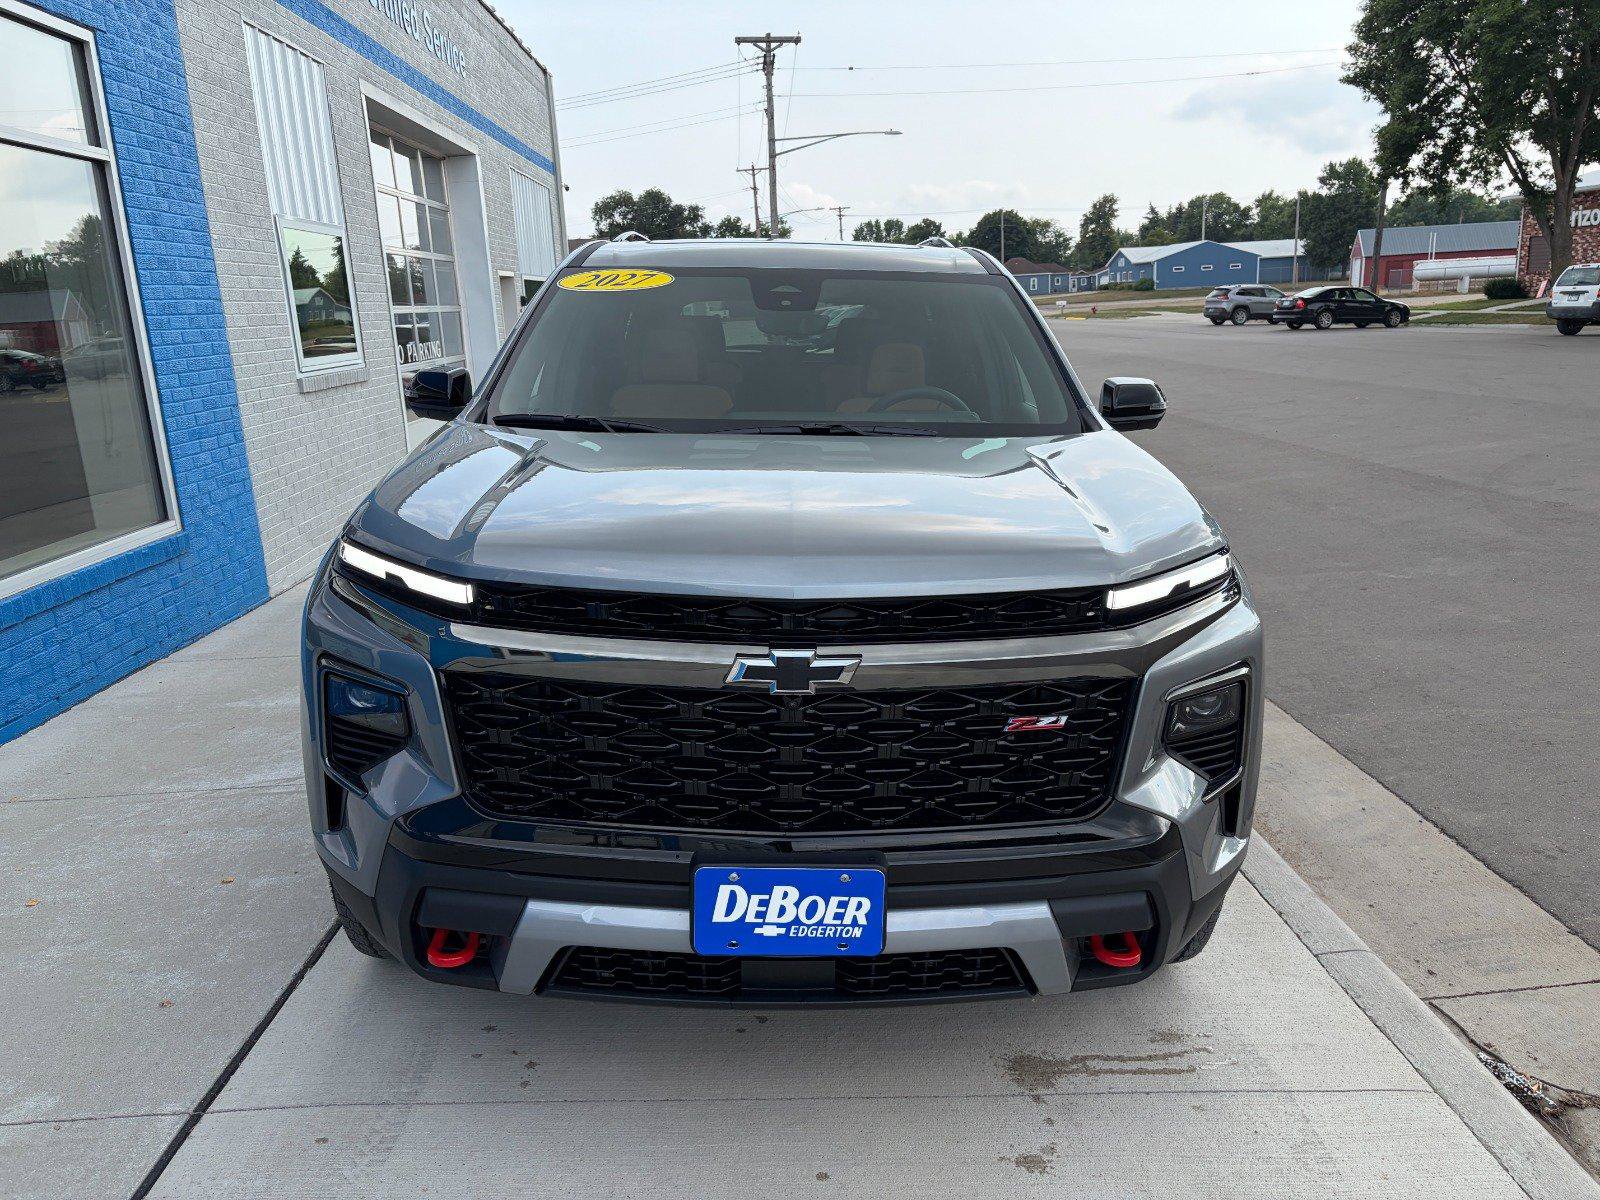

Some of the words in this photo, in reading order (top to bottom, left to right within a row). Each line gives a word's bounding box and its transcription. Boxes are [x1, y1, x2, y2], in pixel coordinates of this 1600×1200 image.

[369, 0, 420, 41] tified
[422, 9, 466, 79] Service
[1570, 205, 1600, 228] rizo
[575, 273, 658, 287] 2027
[406, 340, 442, 363] PARKING
[1003, 715, 1069, 732] Z71
[789, 925, 863, 938] EDGERTON
